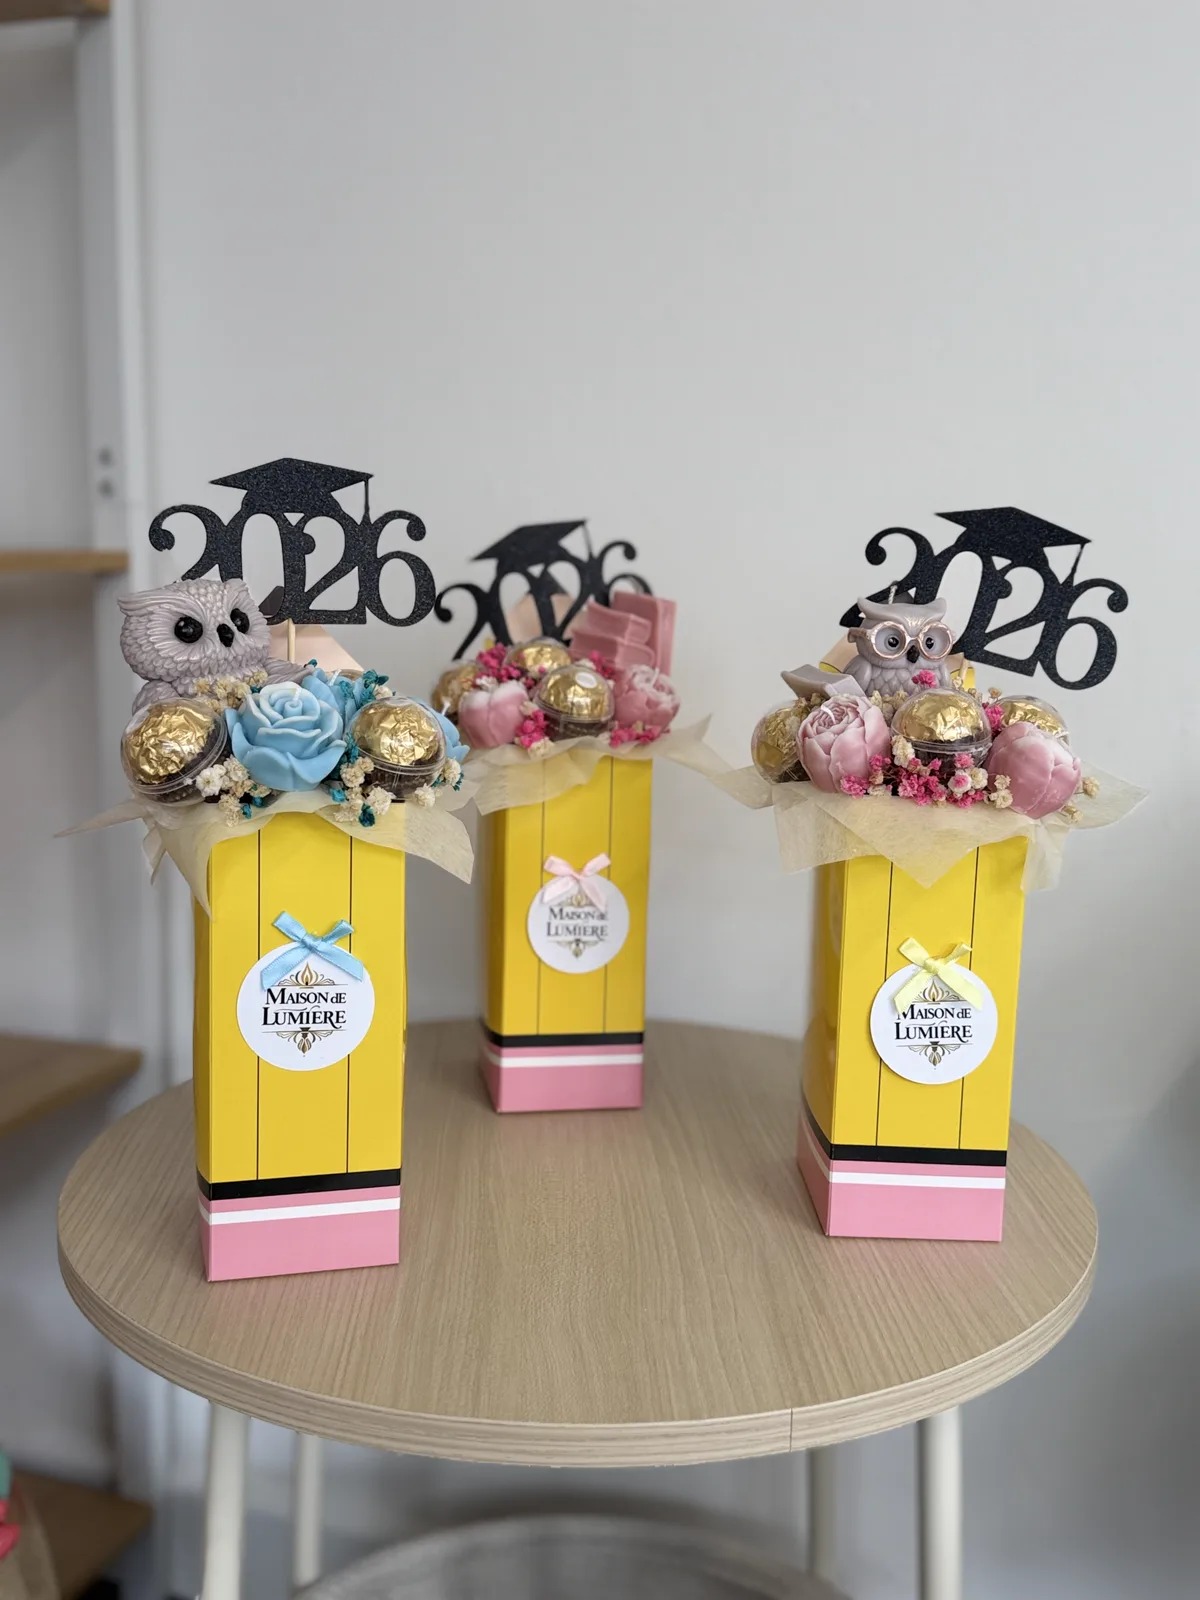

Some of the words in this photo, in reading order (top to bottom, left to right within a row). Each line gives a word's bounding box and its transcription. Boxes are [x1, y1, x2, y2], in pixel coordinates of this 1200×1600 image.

[149, 504, 436, 627] 2026
[840, 526, 1129, 690] 2026
[549, 906, 596, 921] MAISON
[265, 987, 329, 1005] MAISON
[897, 1004, 955, 1021] MAISON
